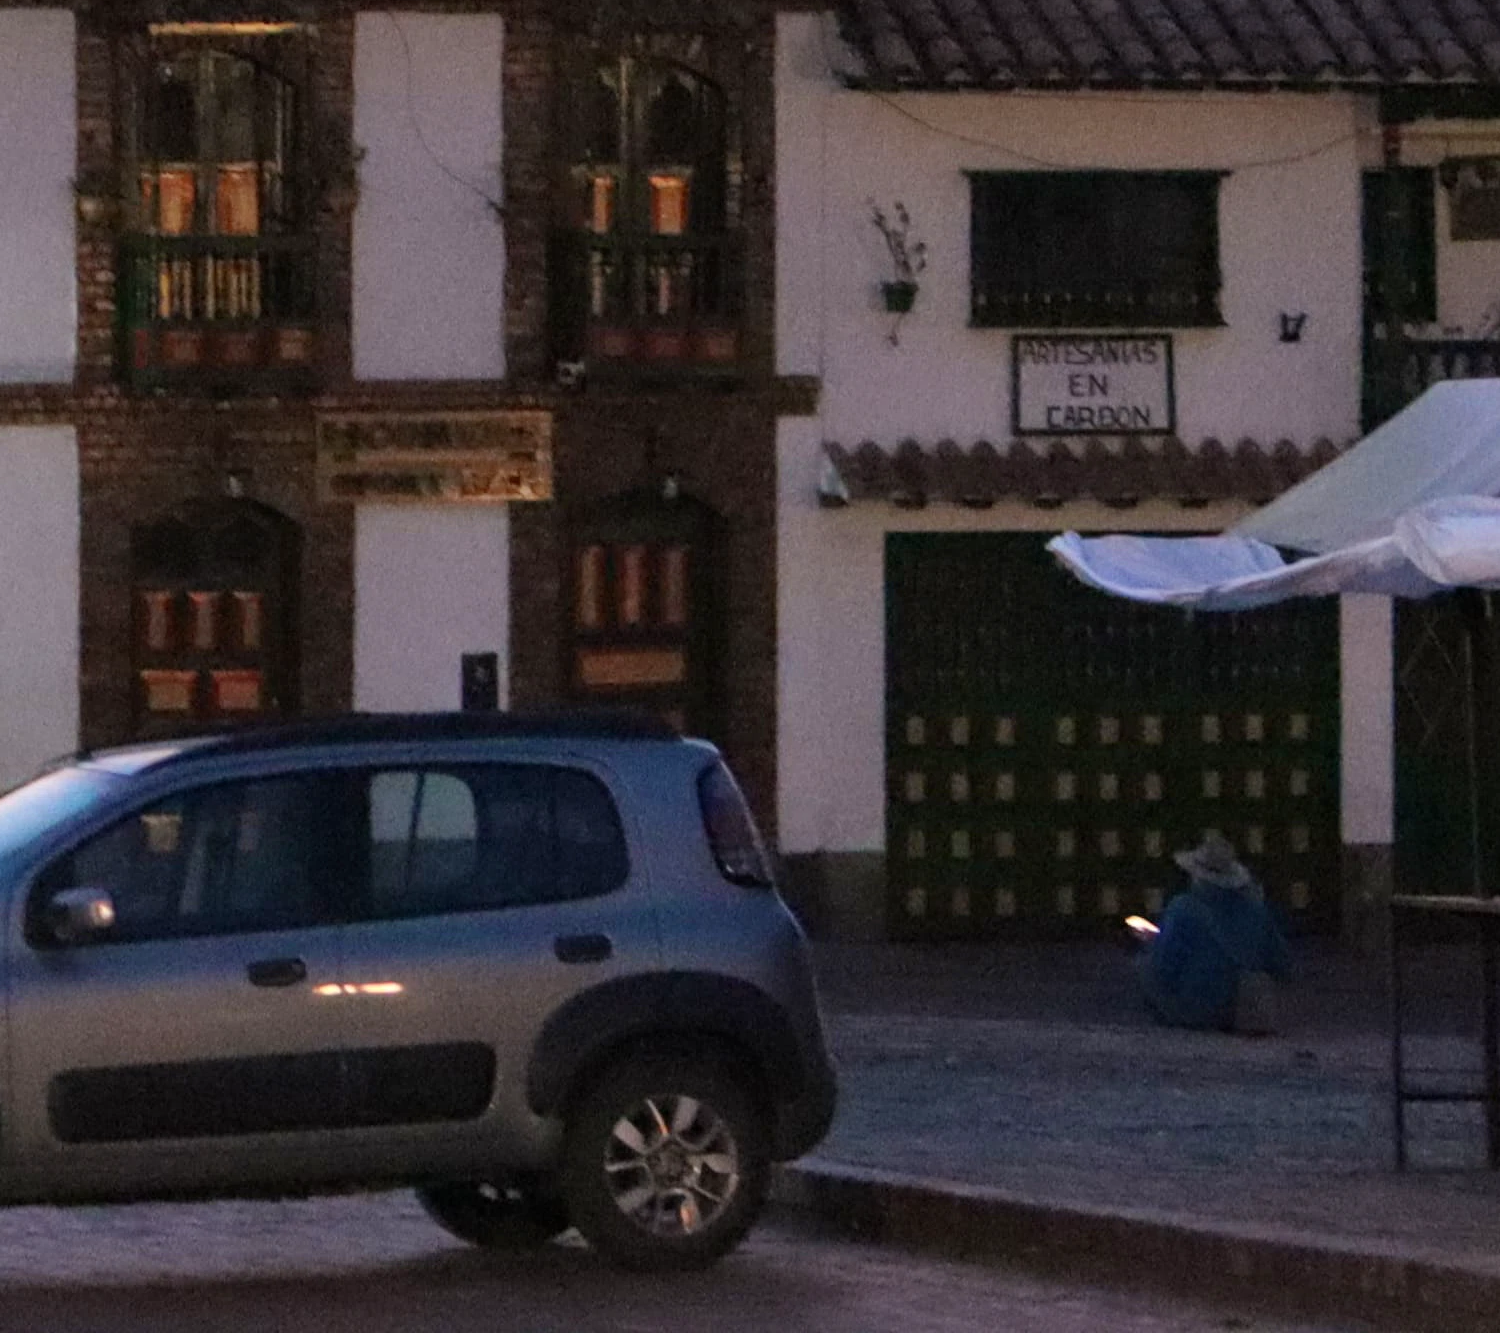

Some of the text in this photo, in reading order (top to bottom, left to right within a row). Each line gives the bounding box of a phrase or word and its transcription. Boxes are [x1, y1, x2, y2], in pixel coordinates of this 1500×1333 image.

[1021, 339, 1158, 366] ARTESANIAS
[1067, 373, 1109, 398] EN
[1046, 405, 1151, 429] CARBON
